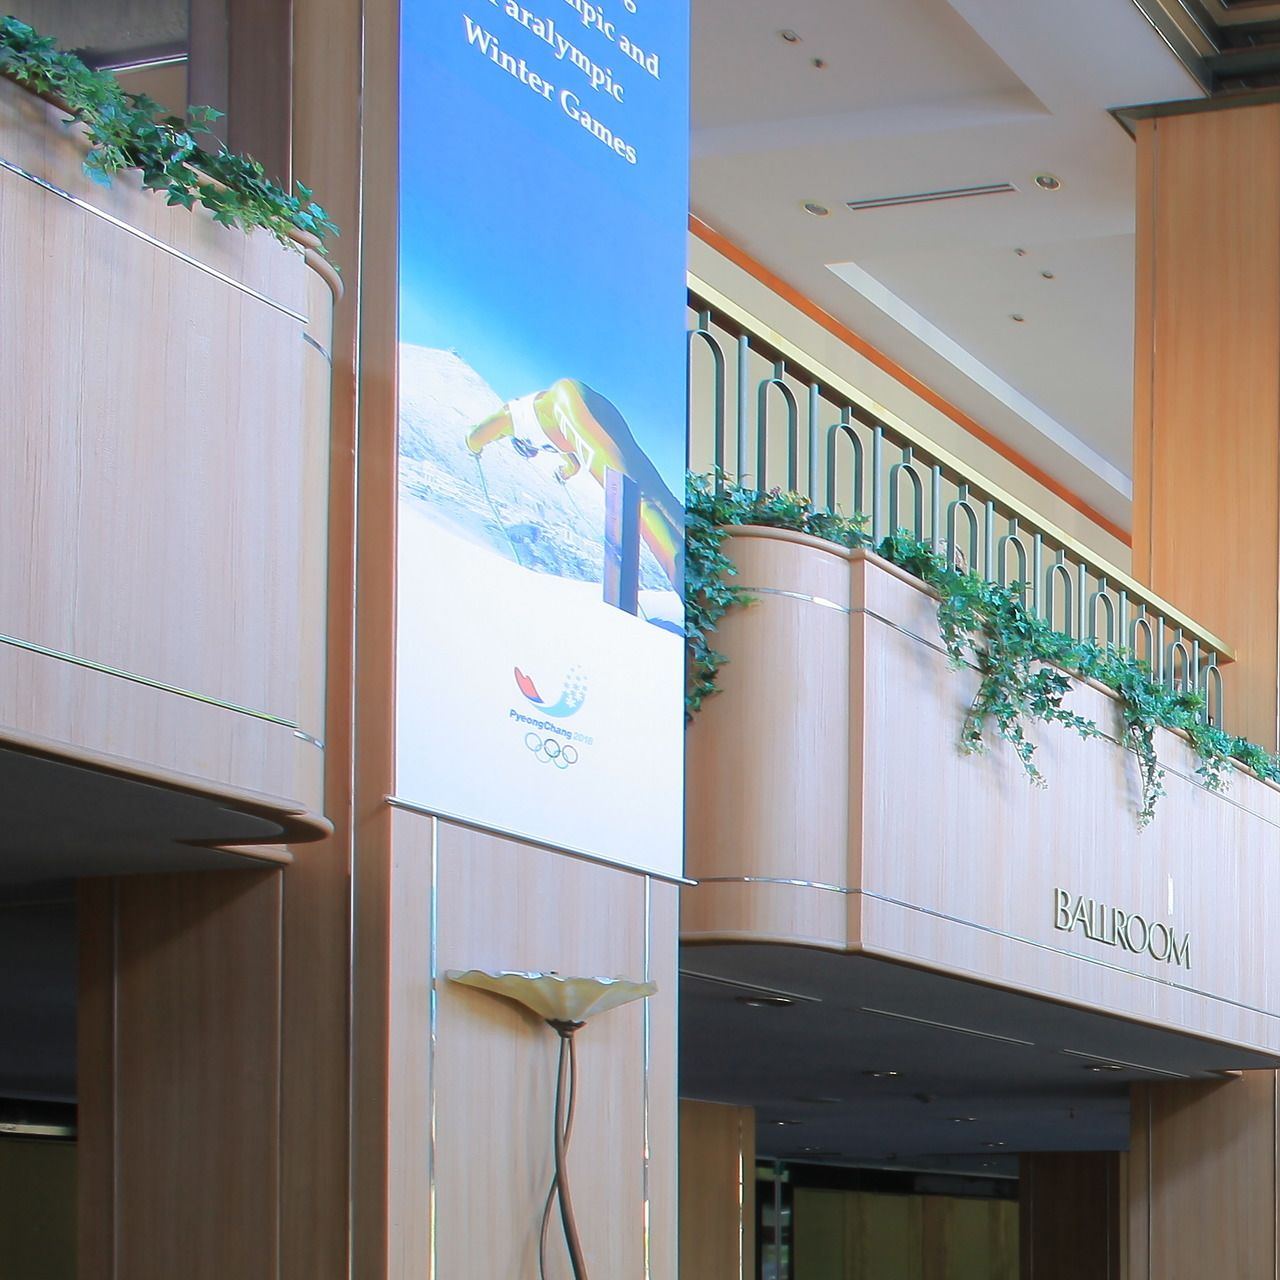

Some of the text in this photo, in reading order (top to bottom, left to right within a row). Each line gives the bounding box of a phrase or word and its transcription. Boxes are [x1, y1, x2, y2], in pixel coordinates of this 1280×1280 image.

[463, 14, 638, 165] Winter Games
[487, 0, 625, 103] aralympic
[619, 35, 661, 80] and
[509, 708, 573, 740] PyeongChang
[1054, 887, 1191, 970] BALLROOM
